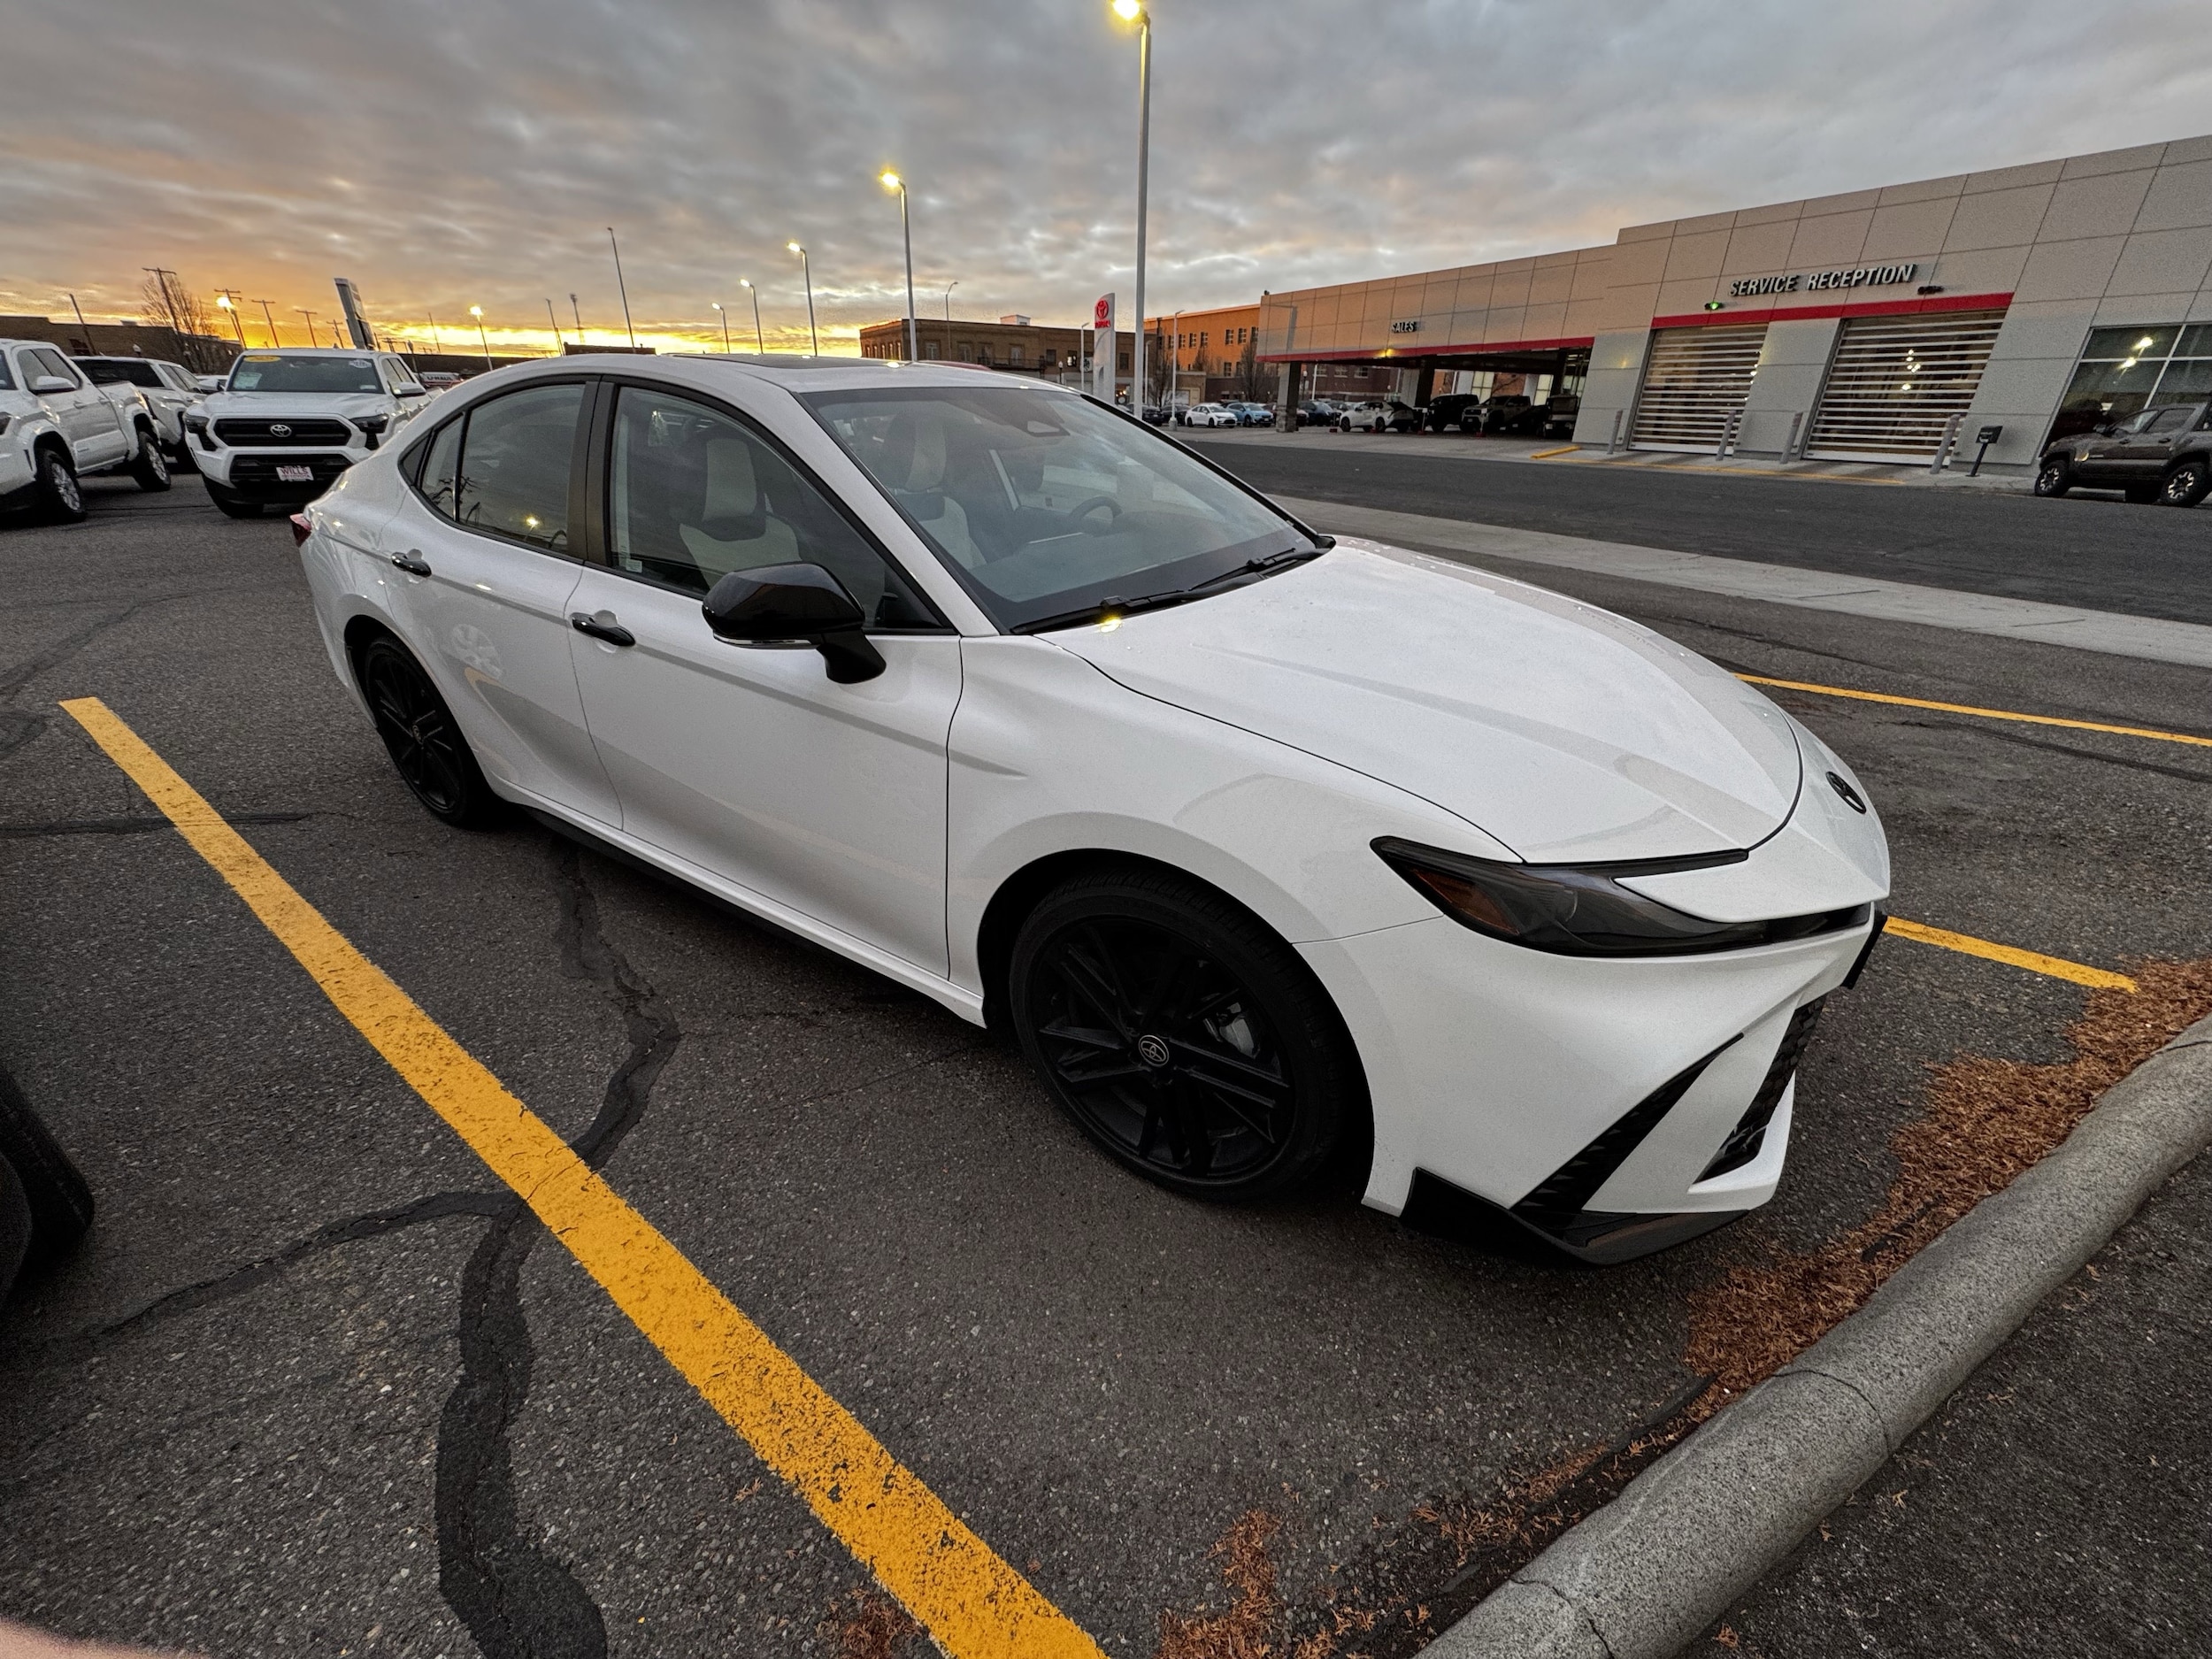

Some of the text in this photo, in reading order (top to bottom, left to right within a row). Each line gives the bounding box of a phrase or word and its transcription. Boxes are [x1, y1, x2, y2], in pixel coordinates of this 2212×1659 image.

[1729, 264, 1916, 296] SERVICE RECEPTION
[1391, 320, 1416, 334] SALES
